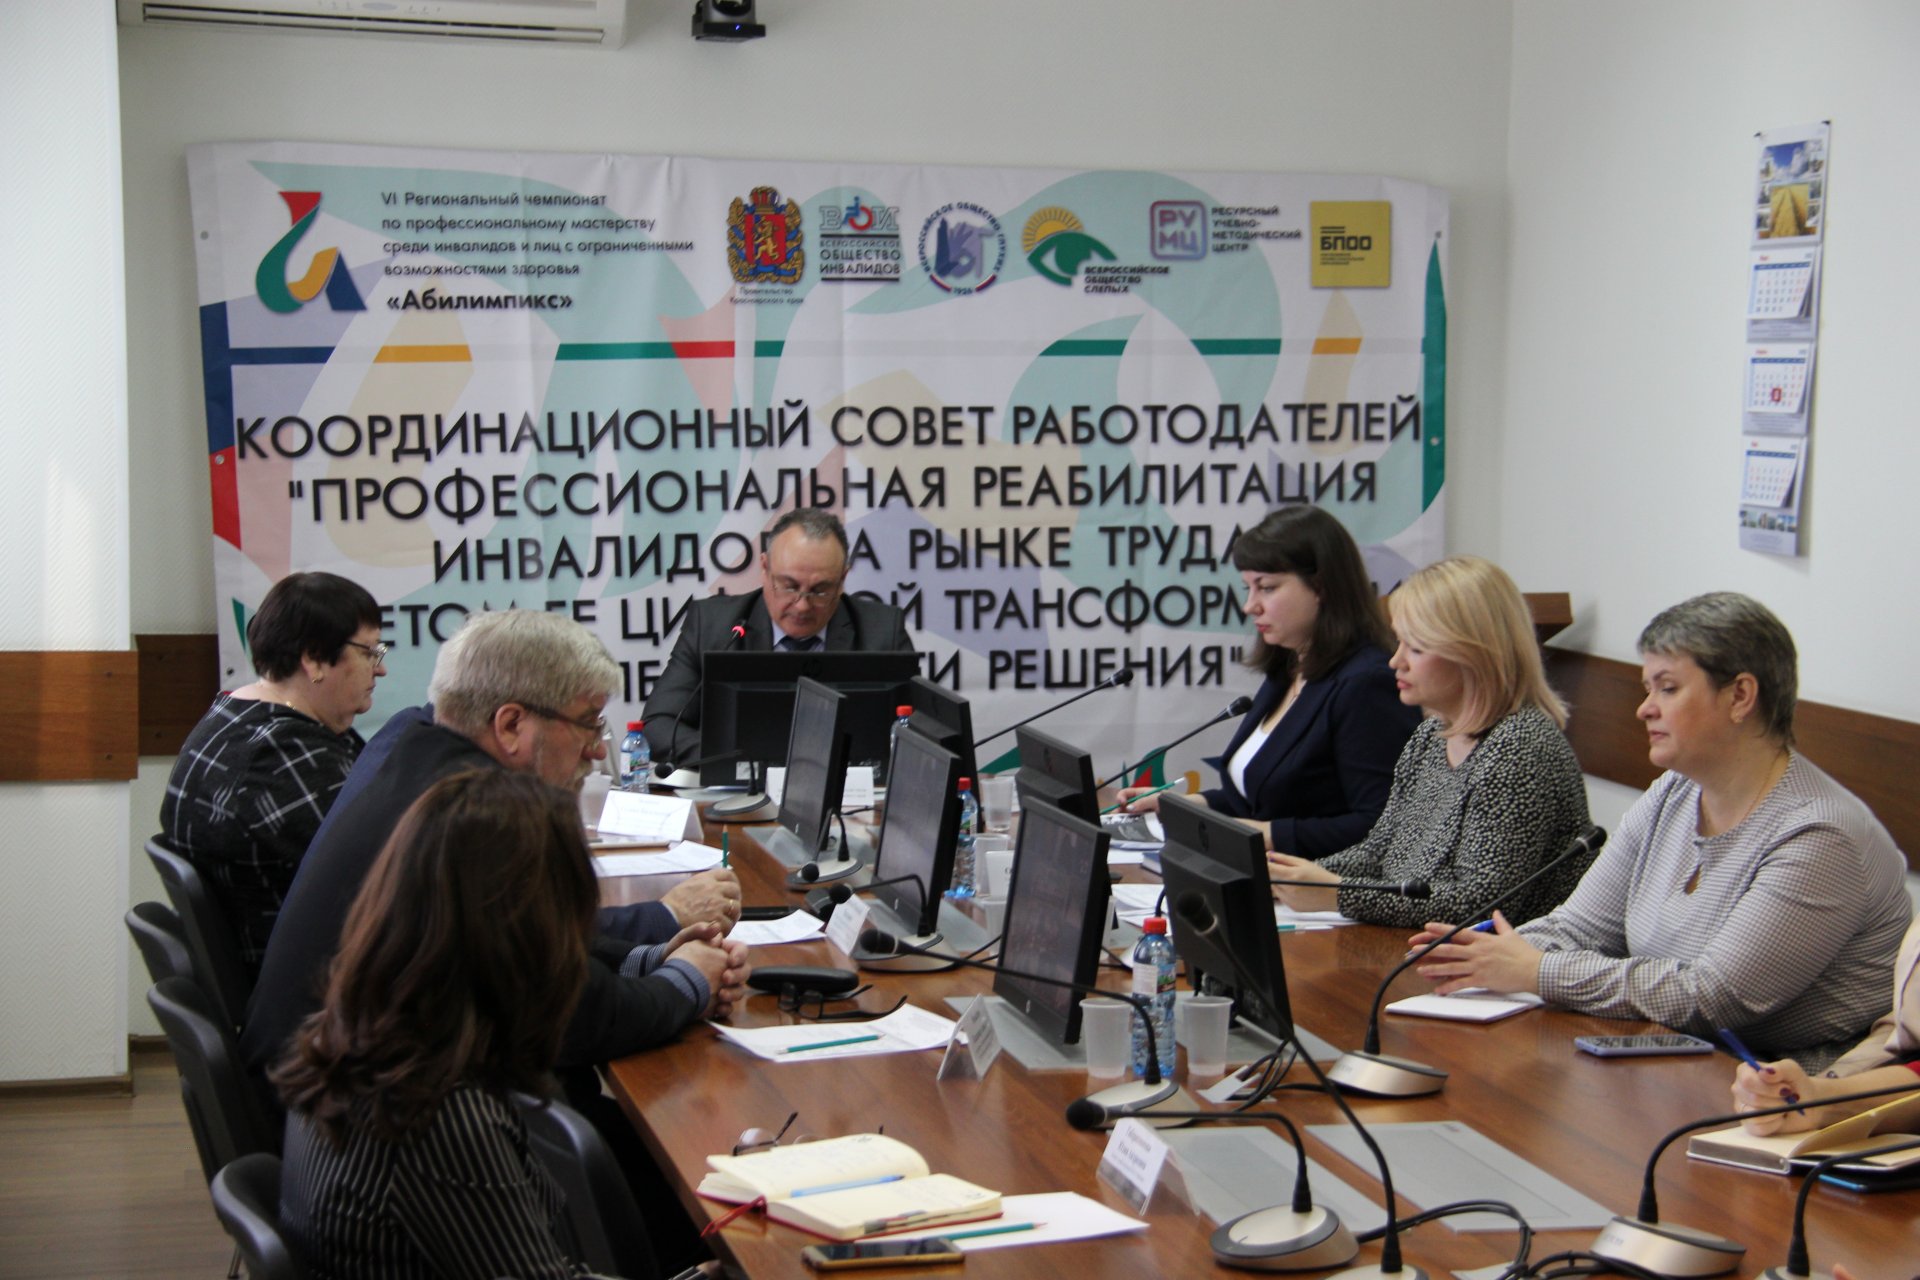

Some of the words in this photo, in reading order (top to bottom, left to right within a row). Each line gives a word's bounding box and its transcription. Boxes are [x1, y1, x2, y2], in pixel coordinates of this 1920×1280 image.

[382, 192, 399, 206] VI
[405, 191, 519, 206] Региональный
[524, 194, 607, 206] чемпионат
[1159, 209, 1197, 228] РУ
[1212, 206, 1279, 215] РЕСУРСНЫЙ
[382, 218, 401, 230] по
[406, 215, 567, 234] профессиональному
[571, 217, 655, 232] мастерству
[383, 241, 429, 255] среди
[435, 240, 517, 254] инвалидов
[522, 241, 531, 252] и
[533, 240, 562, 254] лиц
[565, 242, 574, 252] с
[578, 239, 694, 254] ограниченными
[1159, 231, 1199, 250] МЦ
[1321, 236, 1372, 250] БПОО
[820, 249, 901, 261] ОБЩЕСТВО
[384, 263, 507, 276] возможностями
[512, 263, 580, 277] здоровья
[820, 263, 900, 275] ИНВАЛИДОВ
[1085, 275, 1142, 285] ОБЩЕСТВО
[387, 290, 573, 310] «Абилимпикс»
[236, 400, 810, 463] КООРДИНАЦИОННЫЙ
[830, 405, 995, 447] СОВЕТ
[1012, 394, 1422, 450] РАБОТОДАТЕЛЕЙ
[288, 466, 946, 525] "ПРОФЕССИОНАЛЬНАЯ
[974, 460, 1377, 510] РЕАБИЛИТАЦИЯ
[434, 530, 768, 583] ИНВАЛИДО
[909, 526, 1072, 571] РЫНКЕ
[988, 645, 1243, 690] РЕШЕНИЯ"
